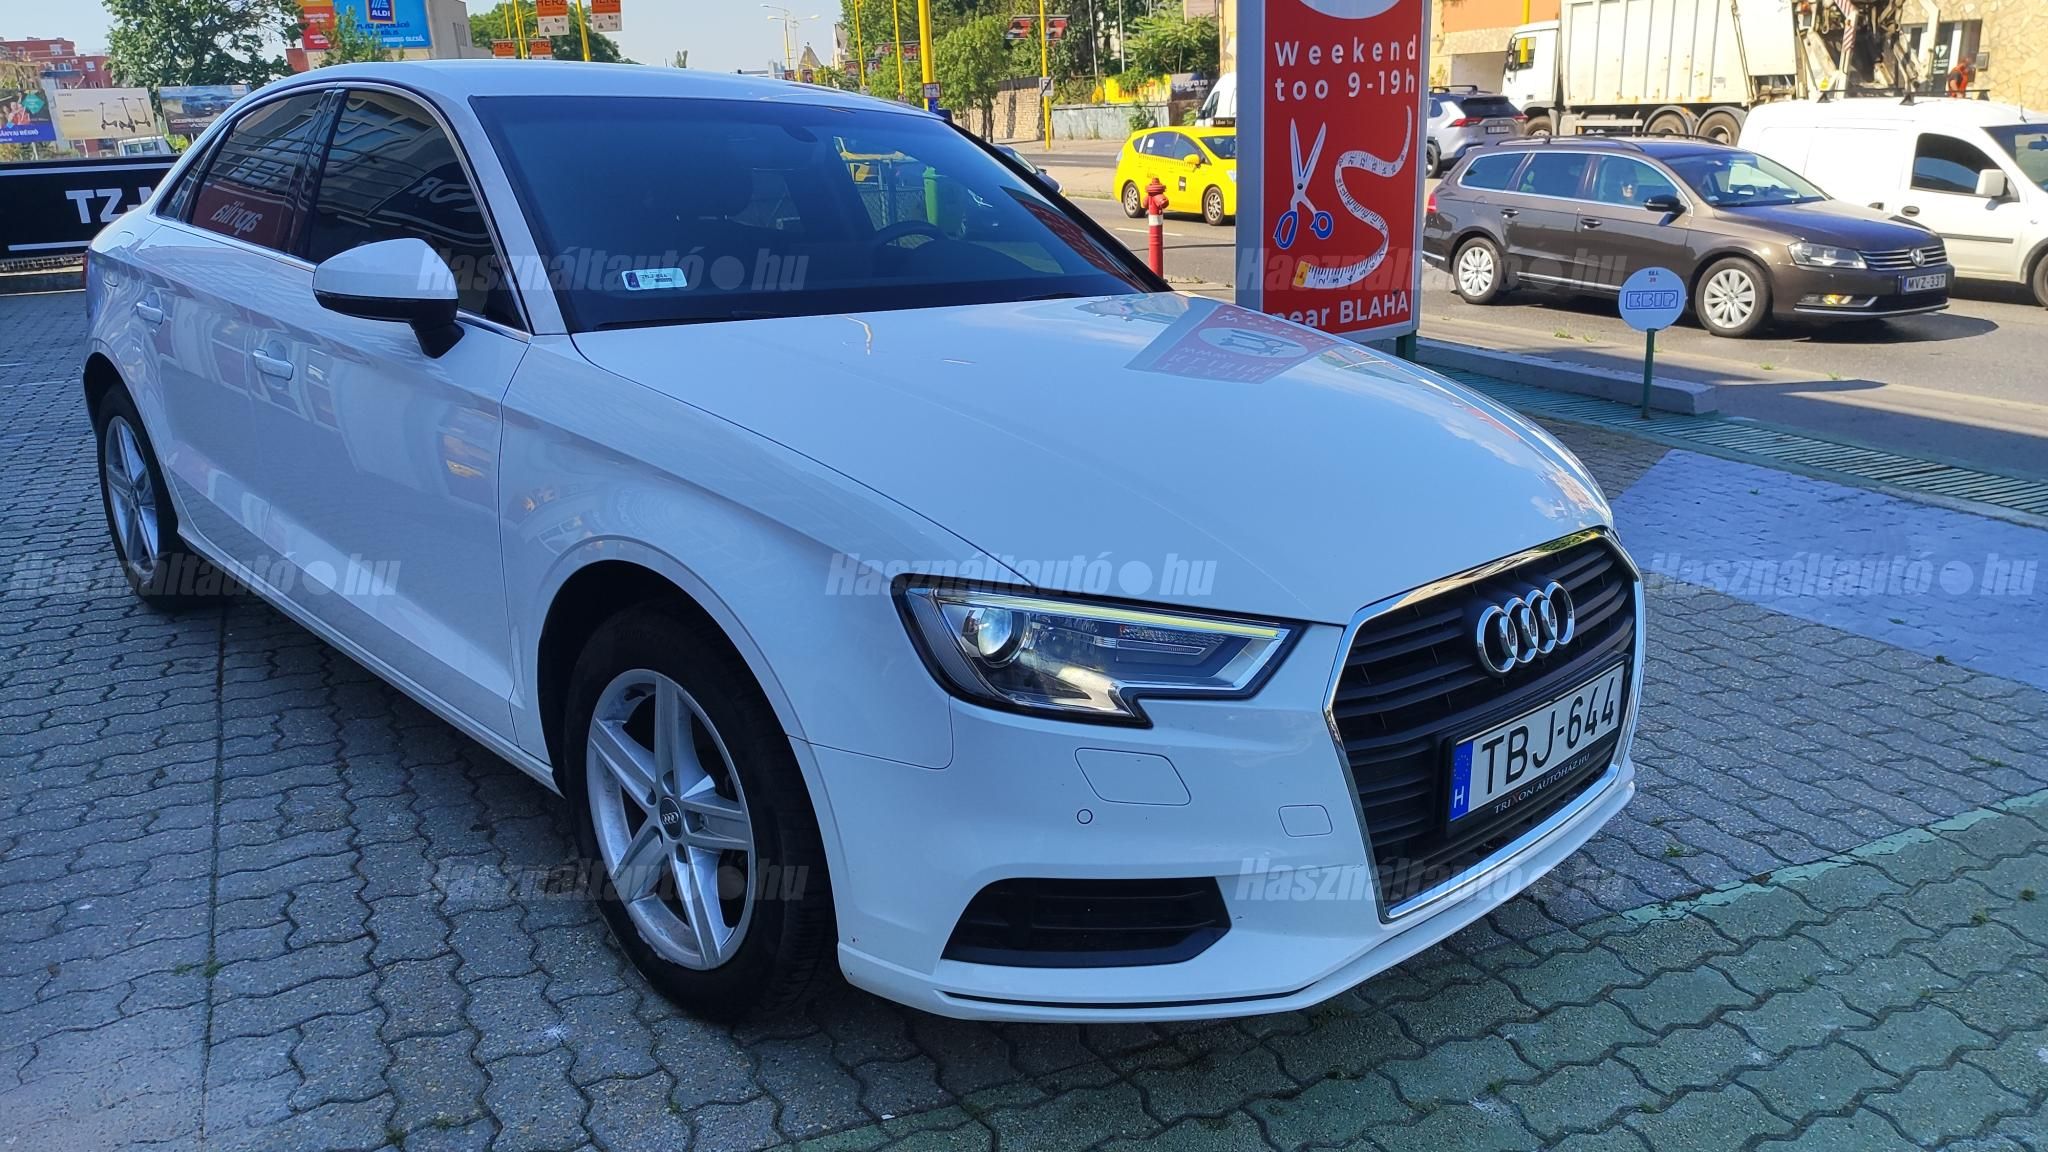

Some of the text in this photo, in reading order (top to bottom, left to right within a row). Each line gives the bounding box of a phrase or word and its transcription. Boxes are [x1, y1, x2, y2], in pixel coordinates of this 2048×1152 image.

[1274, 34, 1416, 67] Weekend
[1275, 68, 1415, 101] too 9-19h
[1908, 275, 1945, 289] MVZ-337
[1339, 290, 1409, 324] BLAHA
[1453, 676, 1615, 809] H TBJ-644
[1494, 785, 1535, 814] TRIXON
